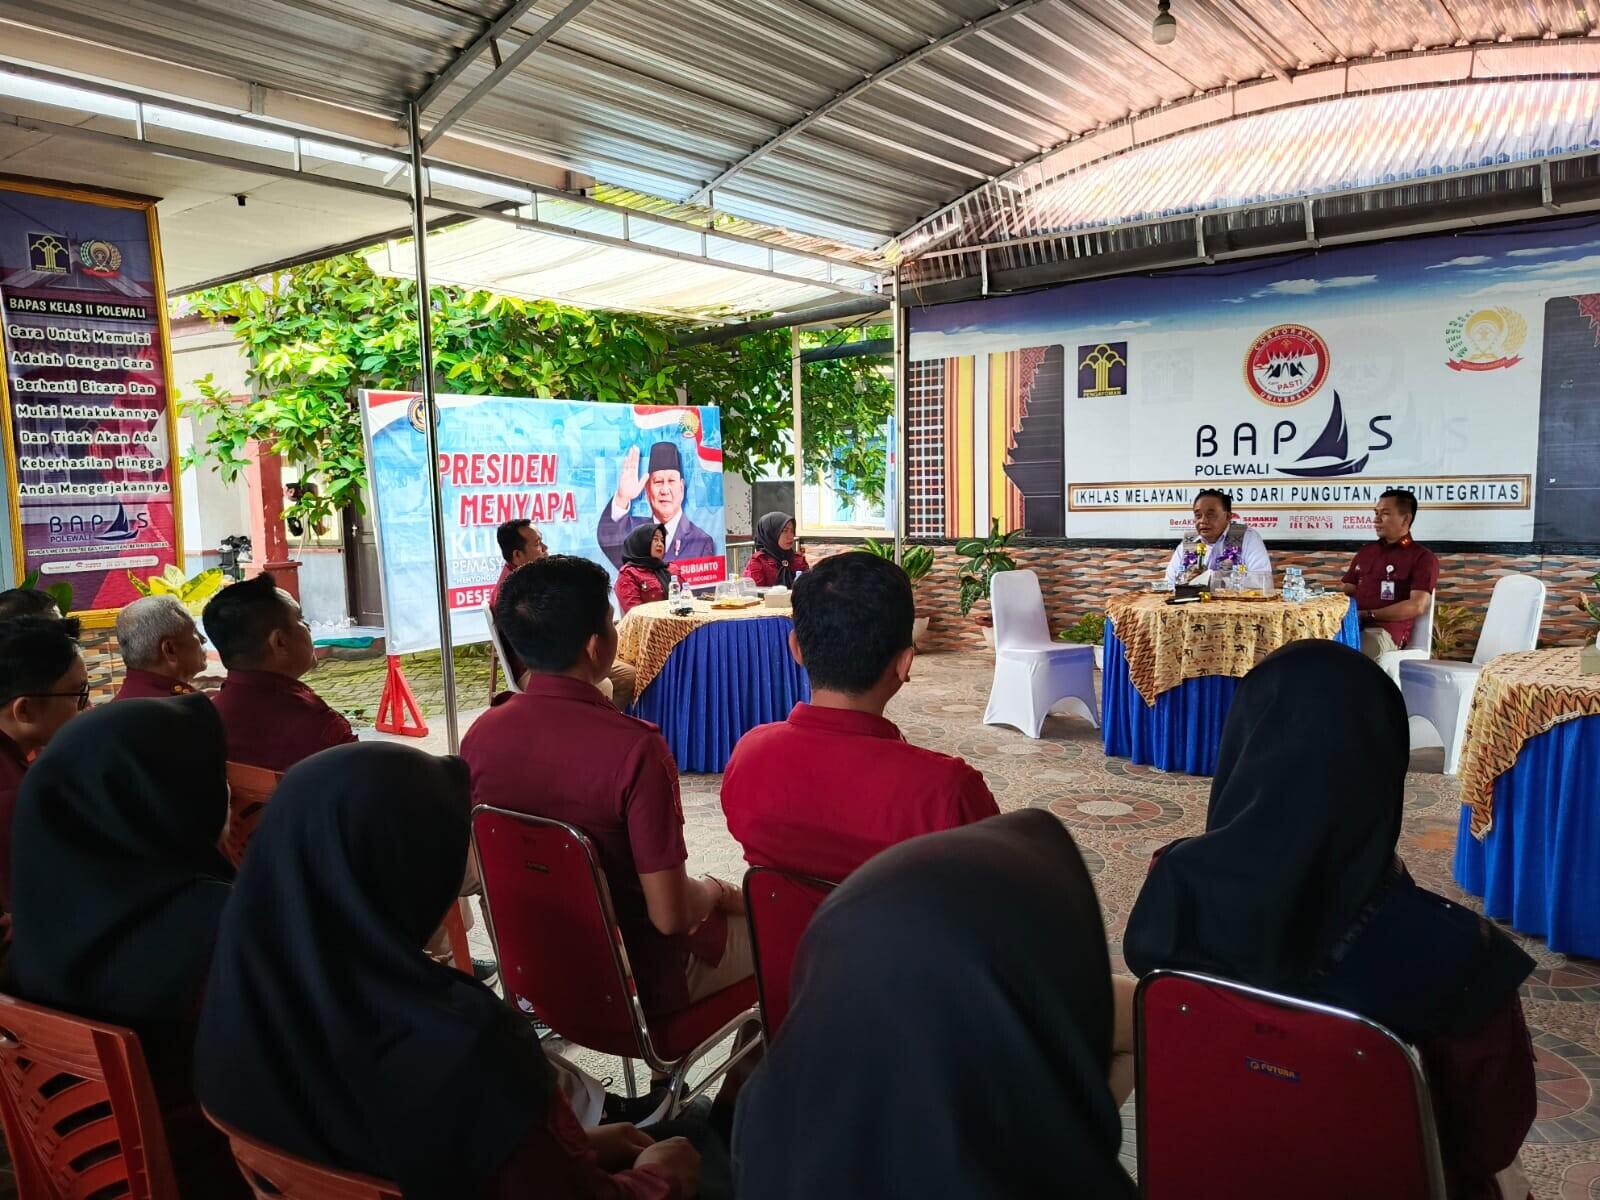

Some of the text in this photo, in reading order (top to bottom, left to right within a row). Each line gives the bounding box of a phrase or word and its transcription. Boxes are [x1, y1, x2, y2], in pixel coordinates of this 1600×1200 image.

[9, 298, 146, 318] BAPAS KELAS II POLEWALI
[9, 325, 150, 344] Cara Untuk Memulai
[1254, 328, 1317, 351] CORPORATE
[13, 352, 153, 370] Adalah Dengan Cara
[15, 379, 154, 394] Berhenti Bicara Dan
[1277, 379, 1303, 391] PASTI
[1259, 383, 1317, 403] UNIVERSITY
[17, 405, 158, 419] Mulai Melakukannya
[21, 432, 158, 443] Dan Tidak Akan Ada
[21, 456, 163, 470] Keberhasilan Hingga
[438, 452, 558, 486] PRESIDEN
[1194, 463, 1269, 476] POLEWALI
[19, 482, 169, 496] Anda Mengerjakannya
[1075, 489, 1119, 503] IKHLAS
[1125, 488, 1192, 504] MELAYANI,
[1250, 487, 1284, 501] DARI
[1291, 485, 1377, 503] PUNGUTAN,
[459, 490, 577, 527] MENYAPA
[50, 535, 91, 543] POLEWALI
[680, 562, 719, 575] SUBIANTO
[1261, 1063, 1295, 1078] FUTURA
